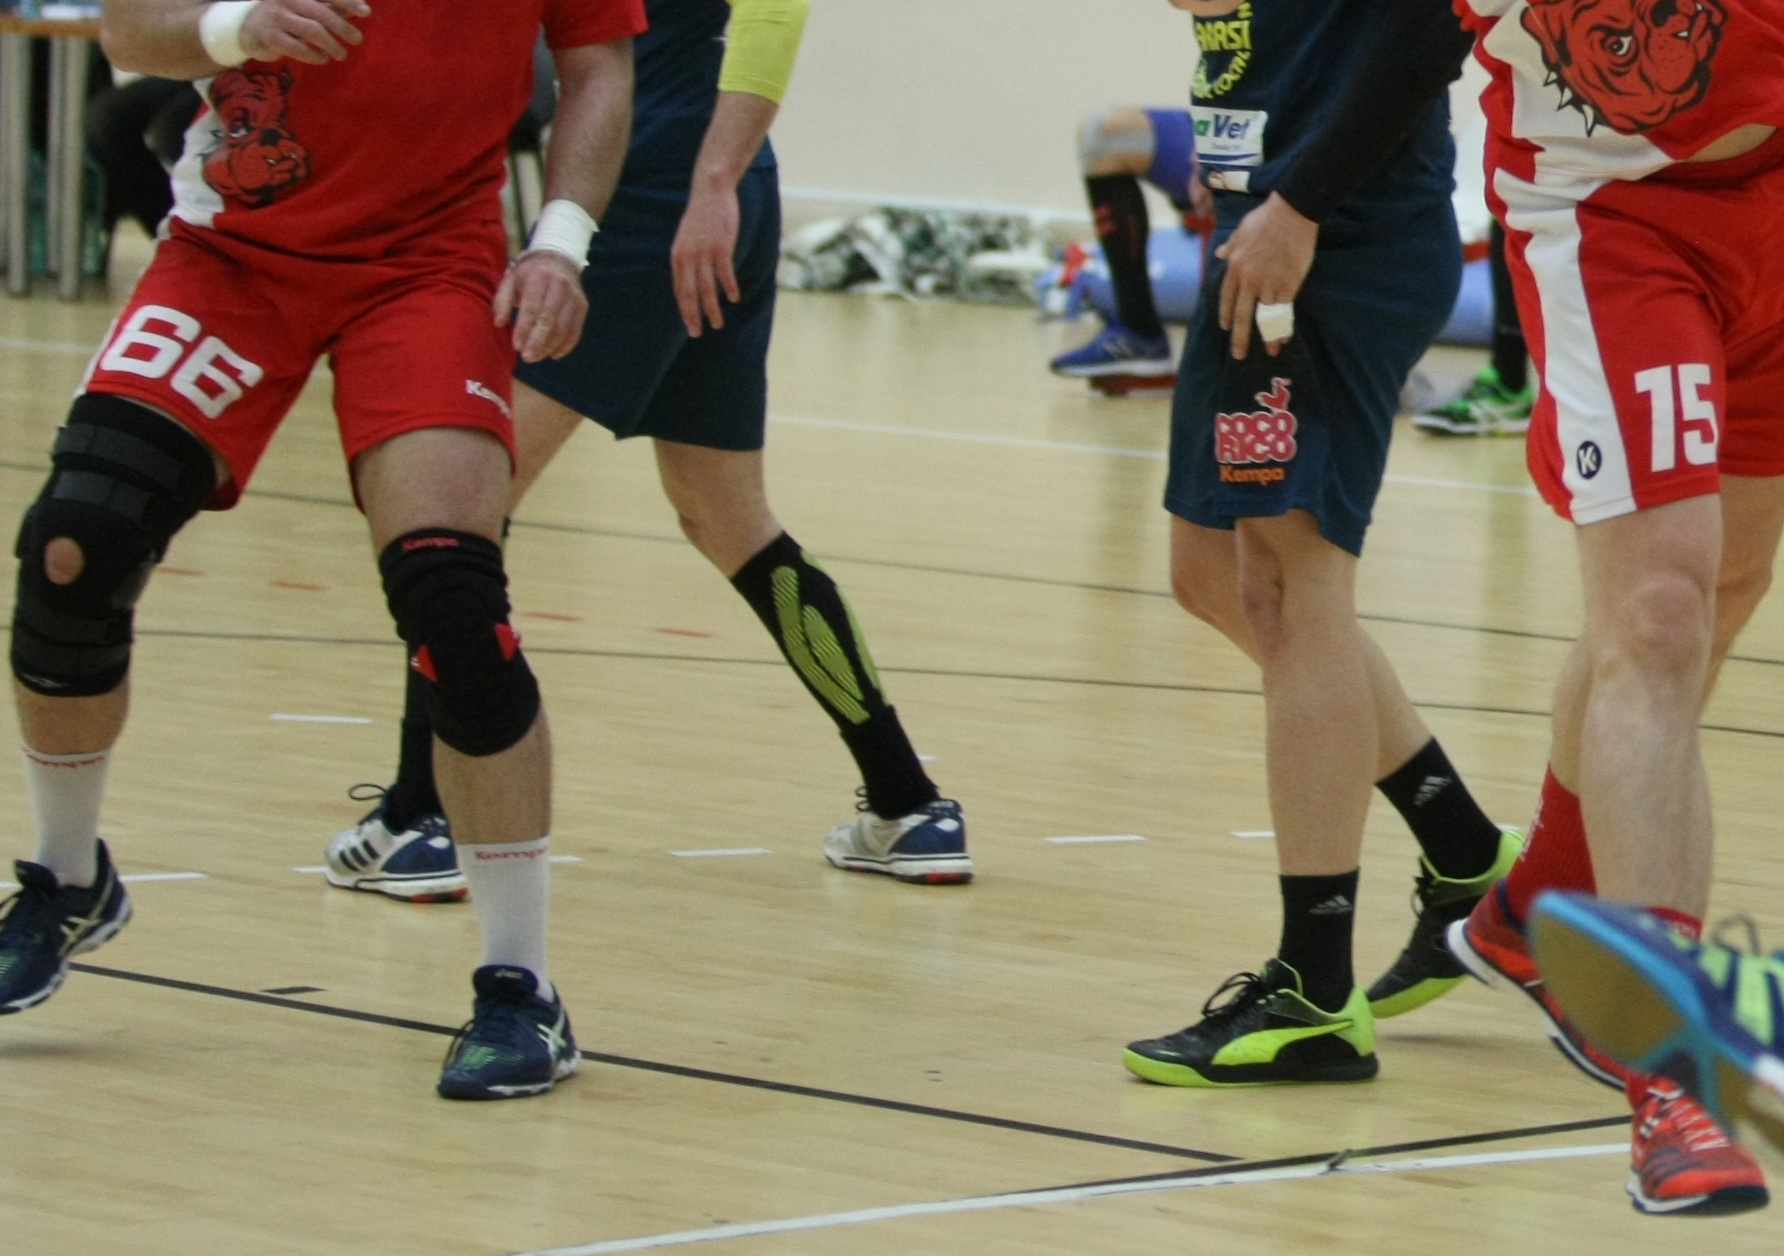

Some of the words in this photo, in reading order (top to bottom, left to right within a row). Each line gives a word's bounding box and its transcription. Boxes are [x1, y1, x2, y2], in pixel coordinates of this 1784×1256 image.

[99, 304, 264, 420] 66
[1634, 362, 1719, 473] 15
[1221, 464, 1286, 486] Kempa
